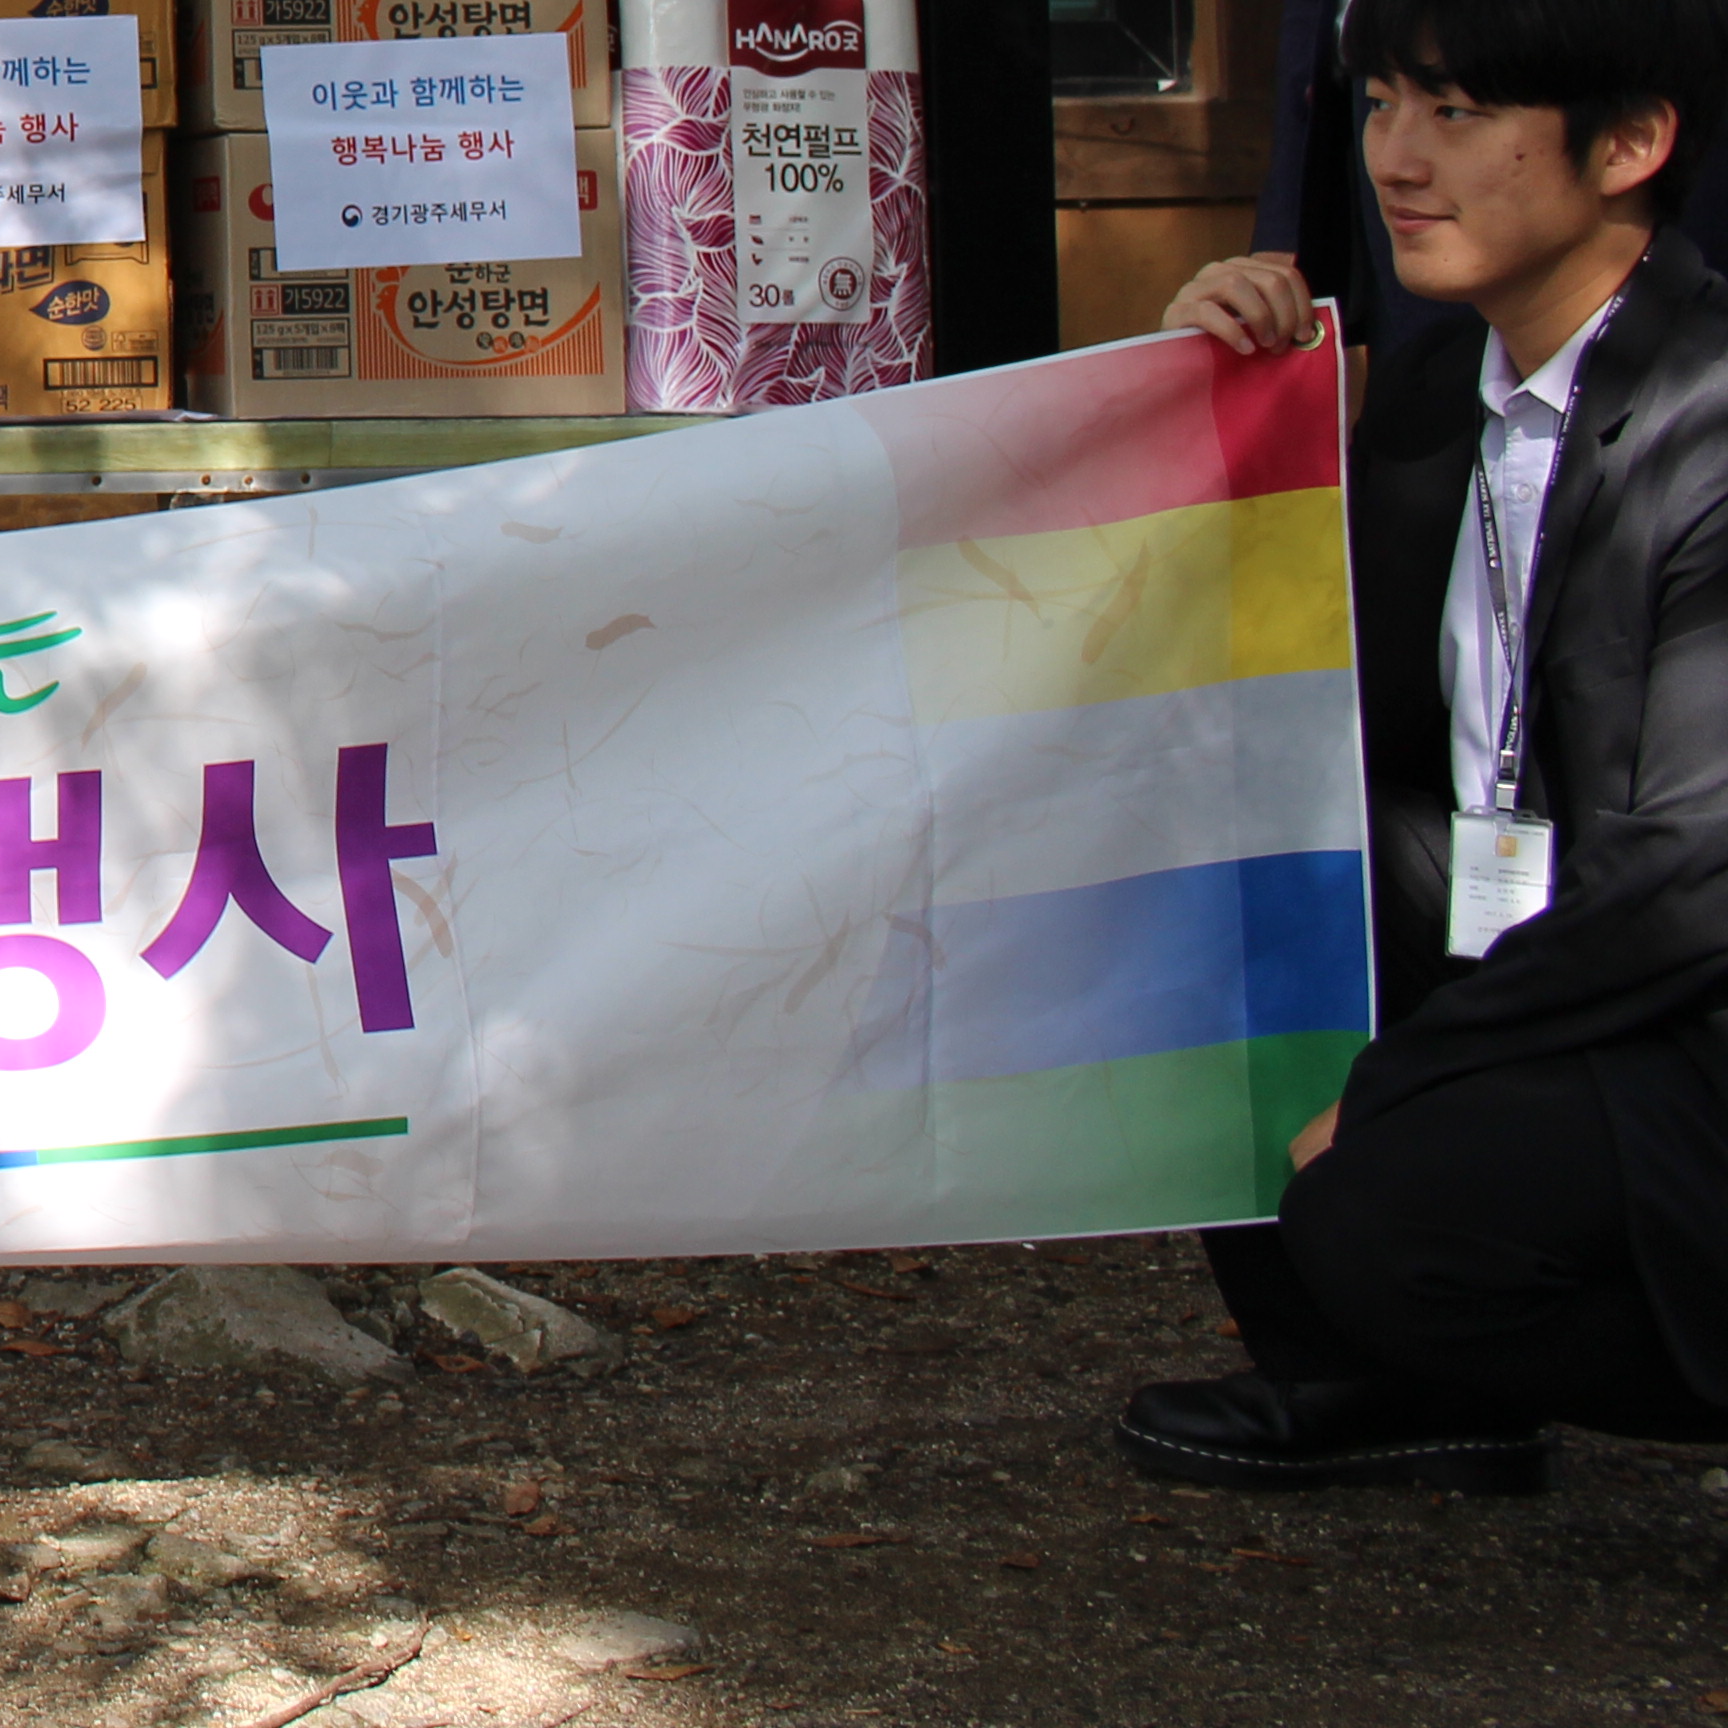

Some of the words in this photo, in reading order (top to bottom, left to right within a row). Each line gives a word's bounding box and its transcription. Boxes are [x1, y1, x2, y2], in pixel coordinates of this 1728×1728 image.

[266, 0, 328, 22] 가5922
[312, 79, 399, 112] 이웃과
[409, 73, 526, 107] 함께하는
[20, 112, 80, 144] 행사
[742, 122, 863, 159] 천연펄프
[330, 134, 446, 167] 행복나눔
[457, 129, 516, 162] 행사
[763, 162, 845, 194] 100%
[371, 199, 508, 226] 경기광주세무서
[47, 286, 100, 320] 순한맛
[285, 287, 347, 311] 가5922
[407, 286, 551, 330] 안성탕면
